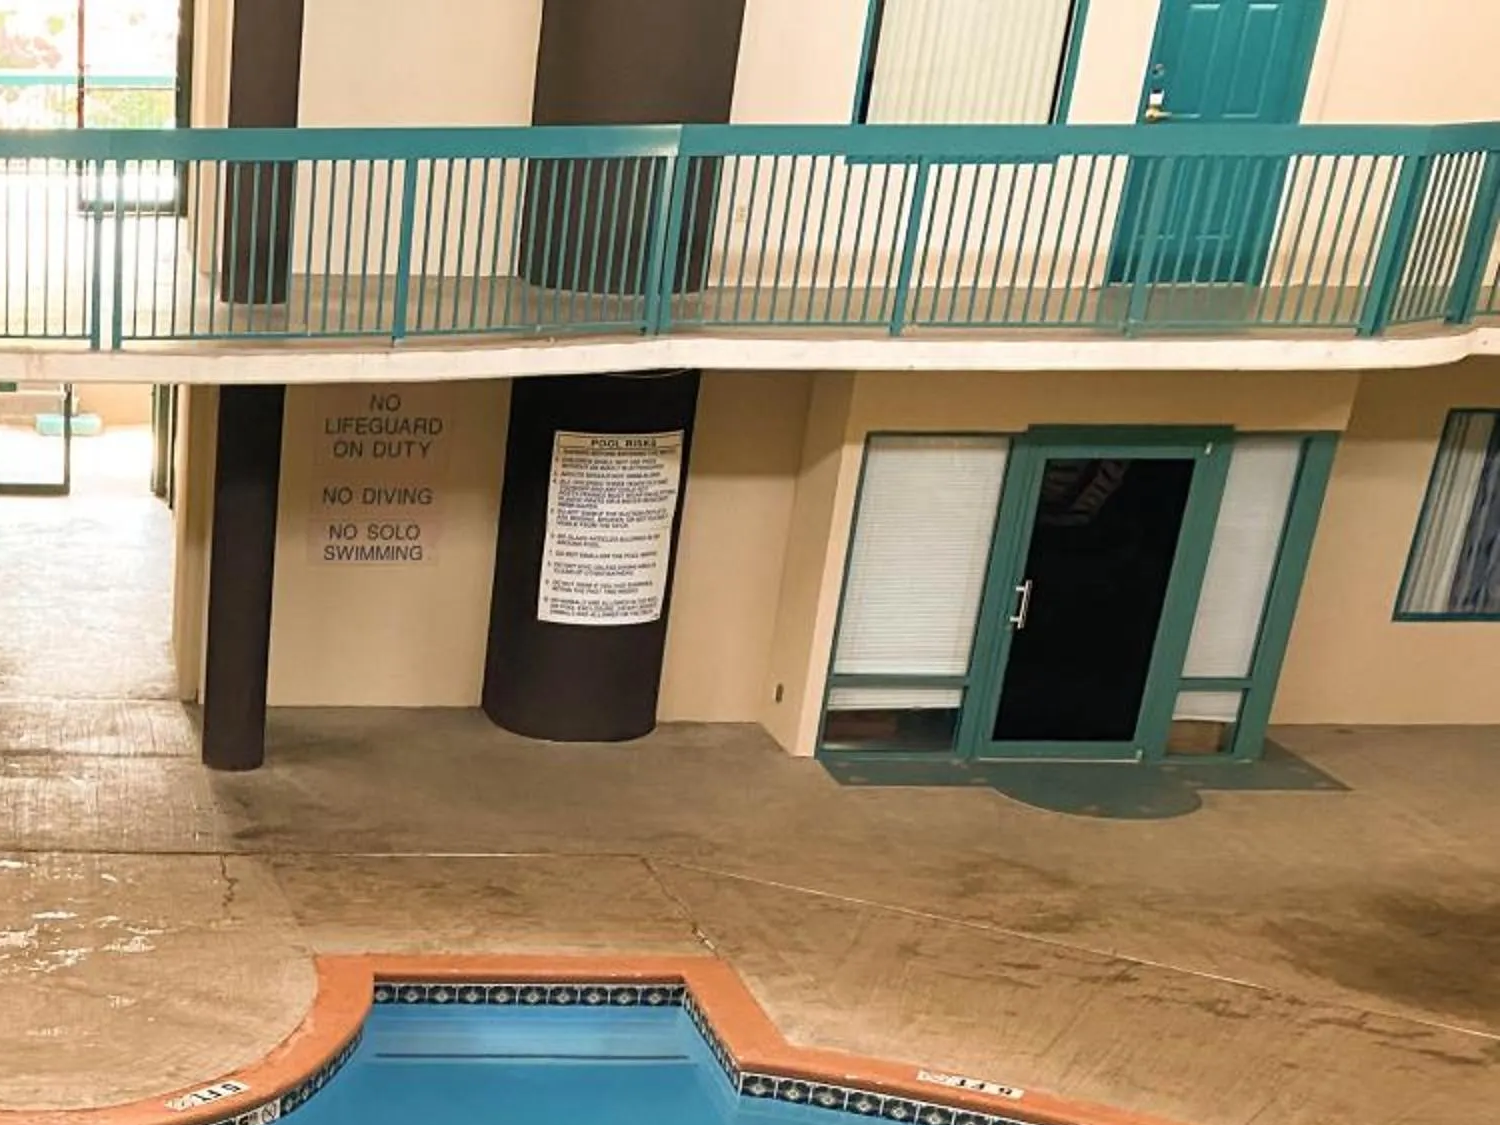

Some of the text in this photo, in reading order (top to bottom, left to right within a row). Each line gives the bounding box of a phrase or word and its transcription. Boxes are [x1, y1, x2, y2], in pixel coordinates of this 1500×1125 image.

[369, 393, 402, 412] NO
[324, 417, 443, 435] LIFEGUARD
[333, 440, 431, 458] ON DUTY
[322, 487, 434, 505] NO DIVING
[329, 524, 421, 541] NO SOLO
[323, 545, 423, 562] SWIMMING
